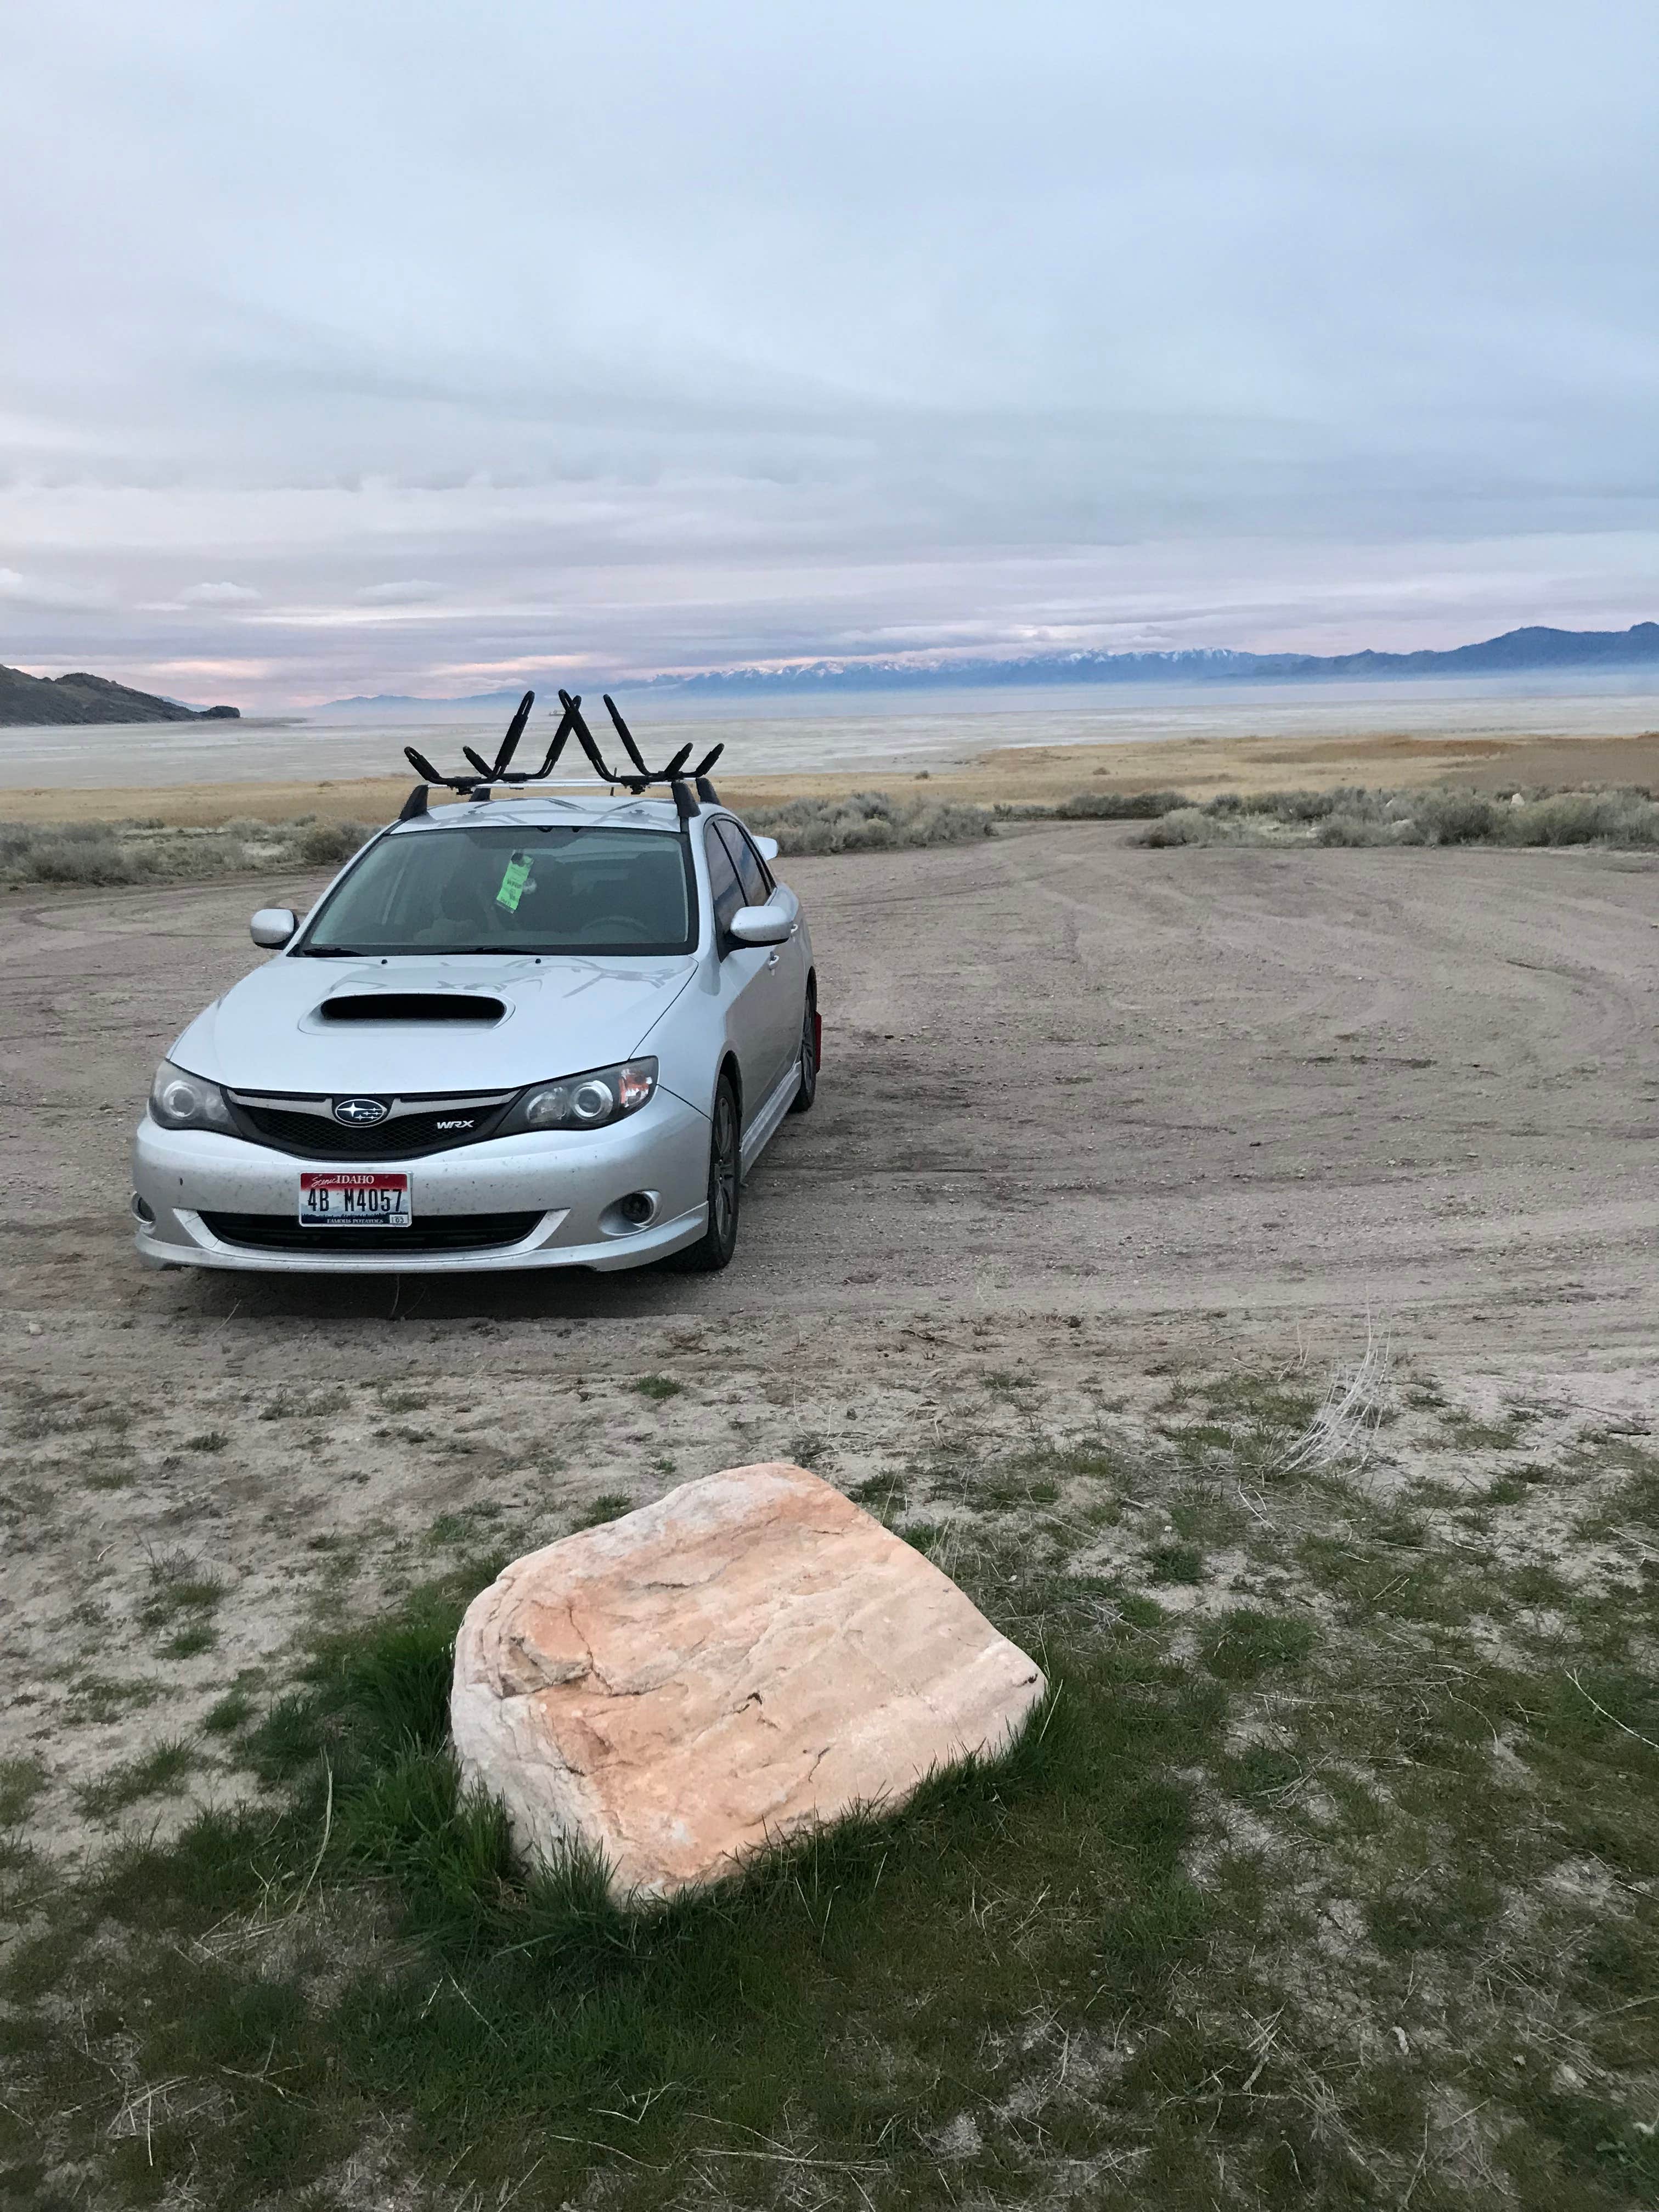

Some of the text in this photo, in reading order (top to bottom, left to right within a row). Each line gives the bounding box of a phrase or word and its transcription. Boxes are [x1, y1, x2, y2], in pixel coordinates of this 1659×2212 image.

[437, 1120, 475, 1129] WRX
[336, 1175, 375, 1184] IDAHO
[308, 1188, 402, 1211] 4B M4057
